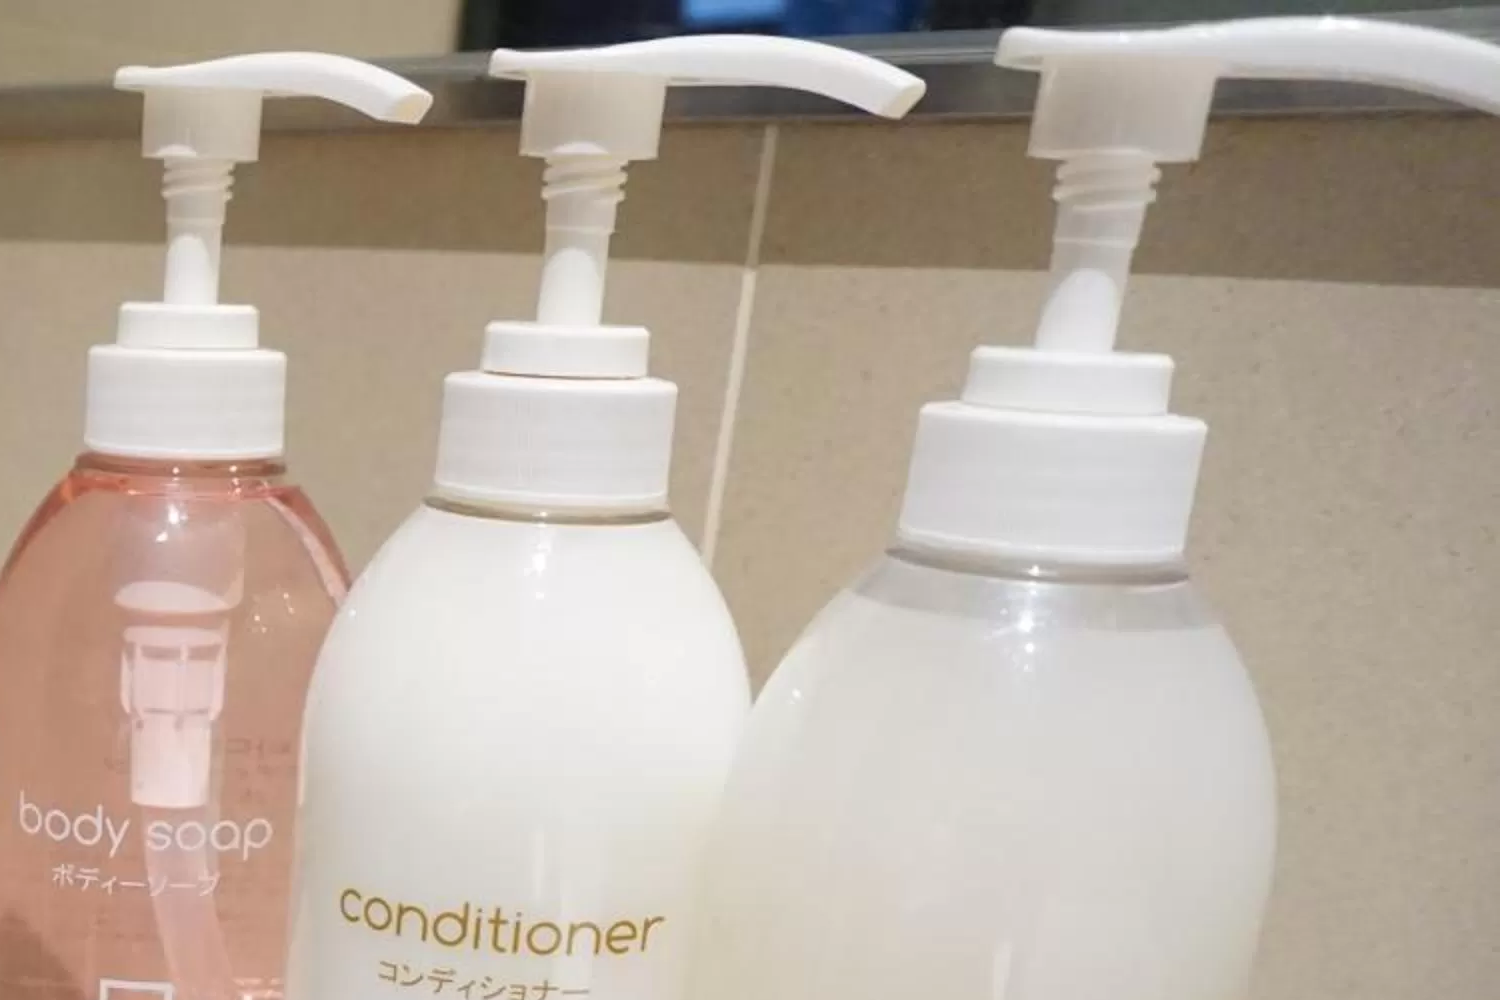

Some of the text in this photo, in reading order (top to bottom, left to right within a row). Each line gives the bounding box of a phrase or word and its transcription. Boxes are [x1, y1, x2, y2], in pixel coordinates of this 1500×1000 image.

[19, 790, 273, 860] body soap
[340, 888, 666, 956] conditioner
